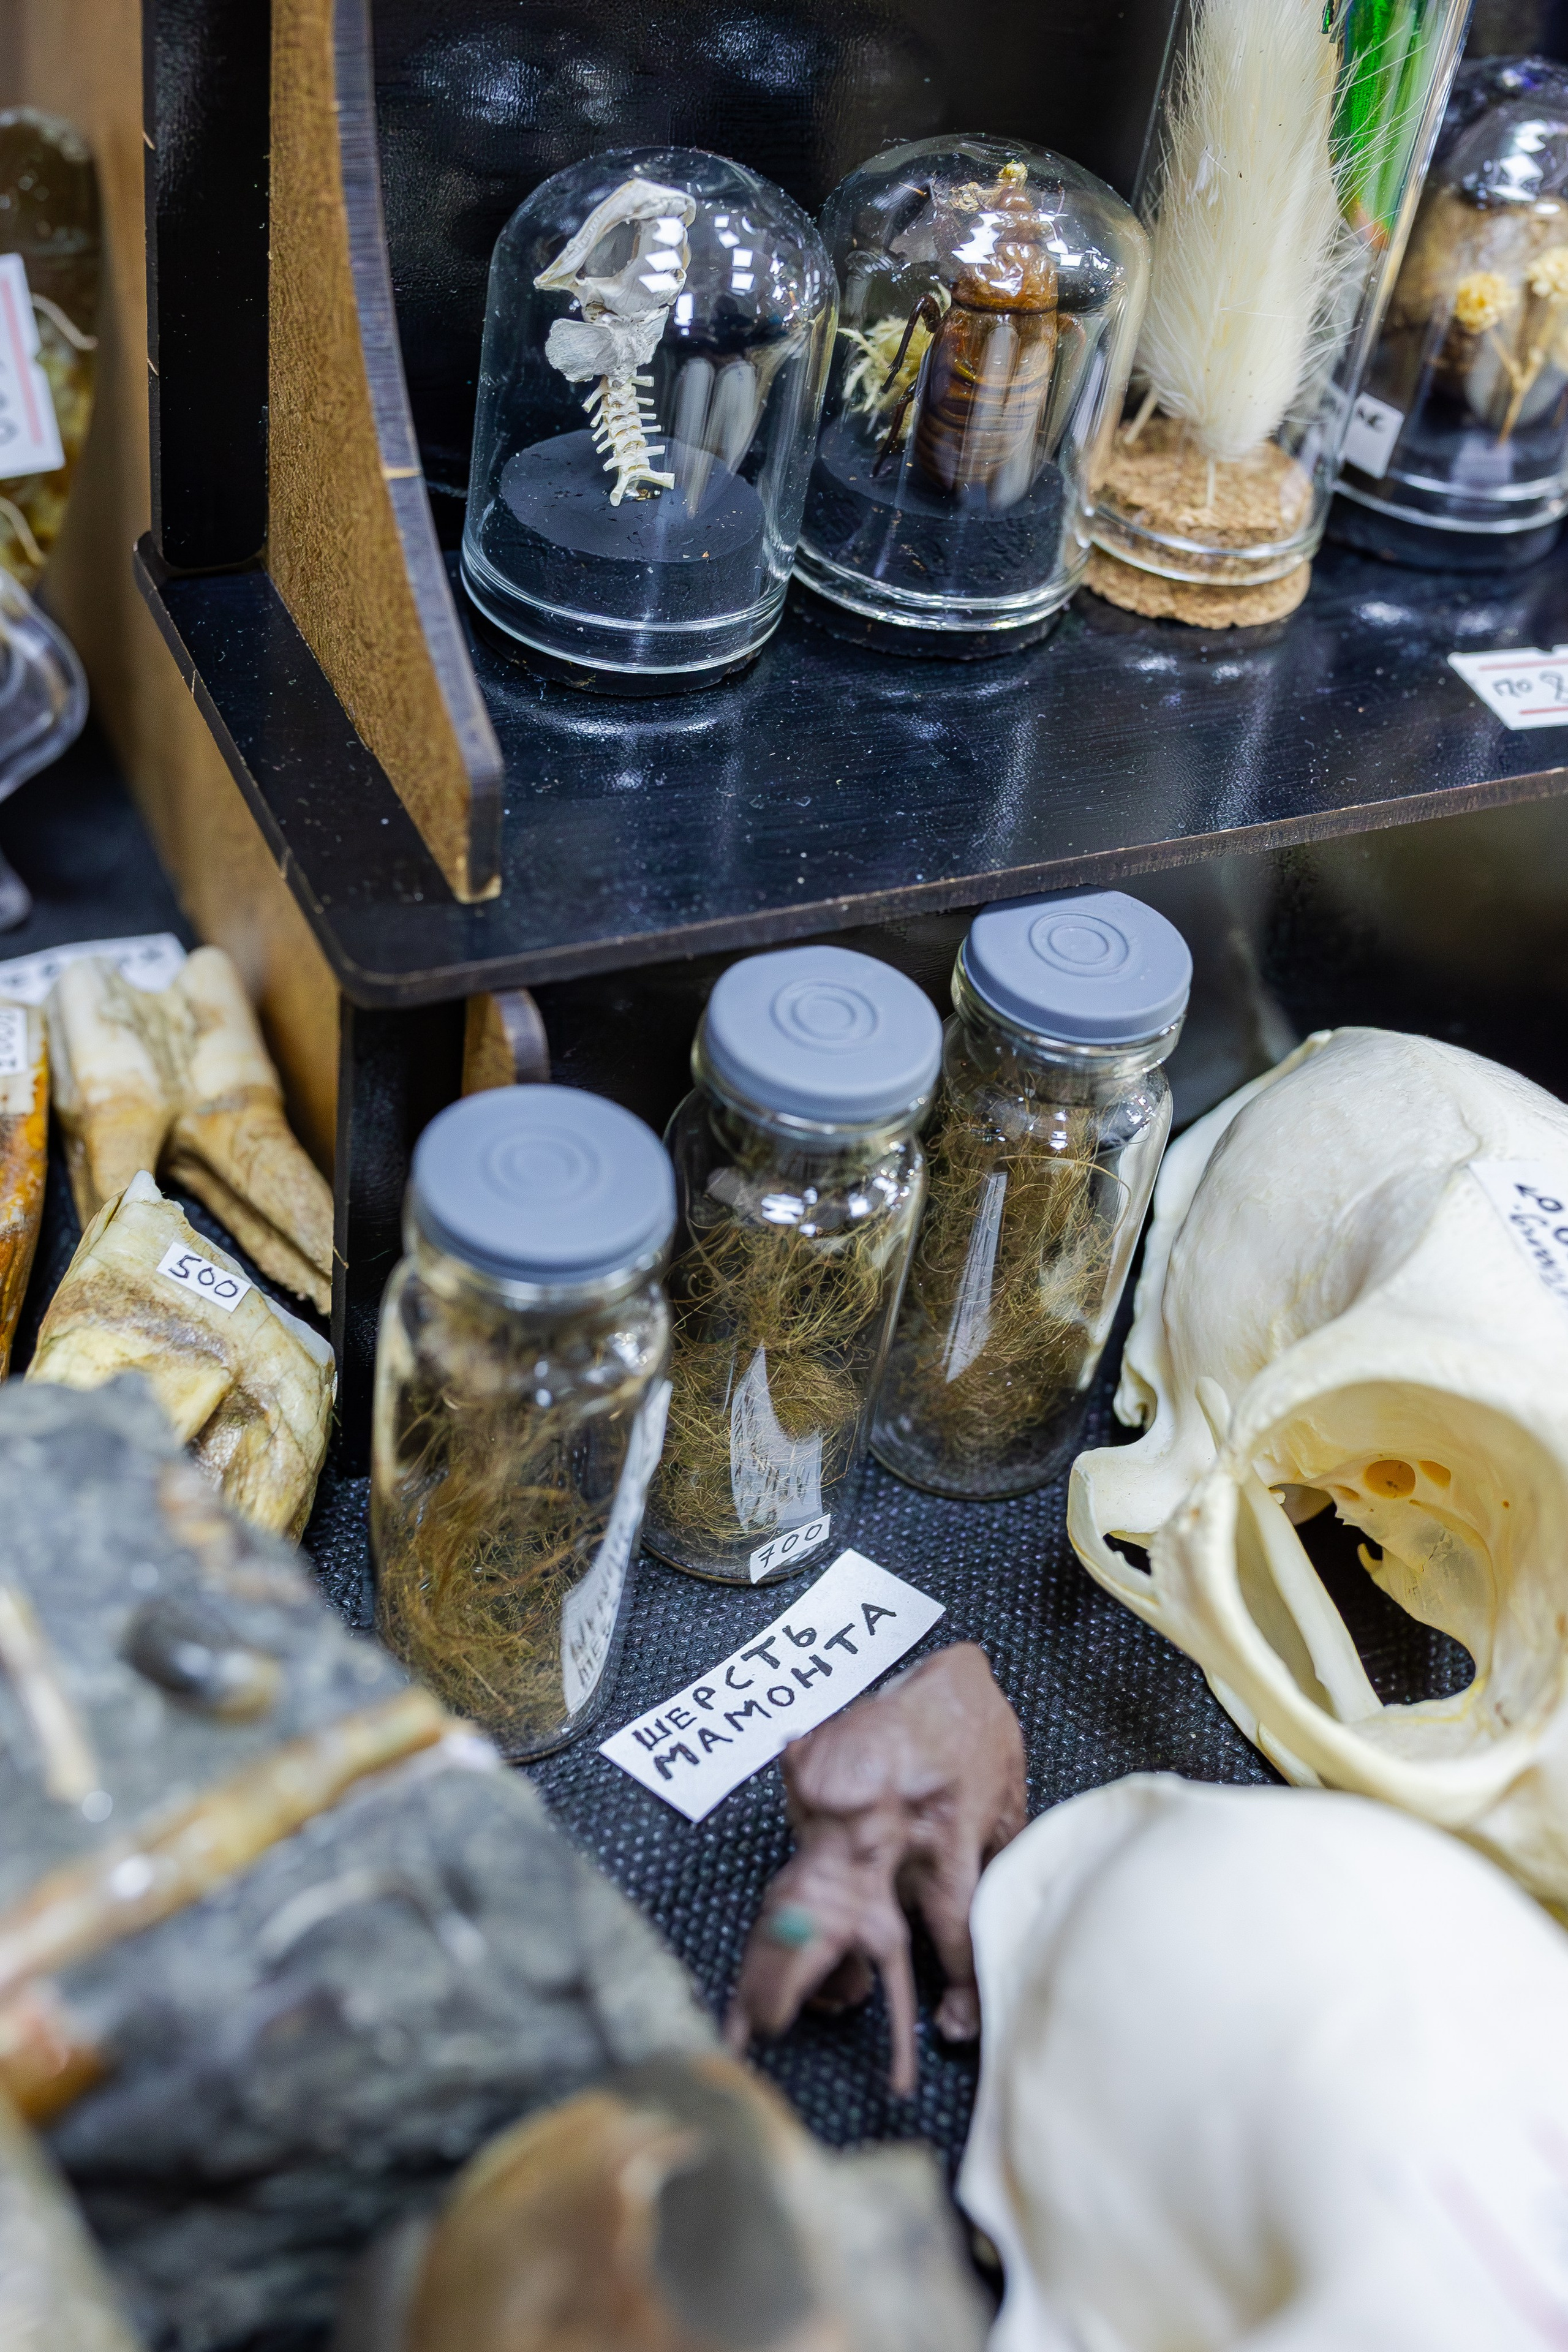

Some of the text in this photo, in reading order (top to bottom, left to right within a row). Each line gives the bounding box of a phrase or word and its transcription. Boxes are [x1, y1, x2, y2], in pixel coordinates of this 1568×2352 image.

[168, 1254, 239, 1298] 500
[758, 1523, 823, 1568] 700
[631, 1625, 818, 1751] ШЕРСТЬ
[653, 1602, 897, 1780] МАМОНТА
